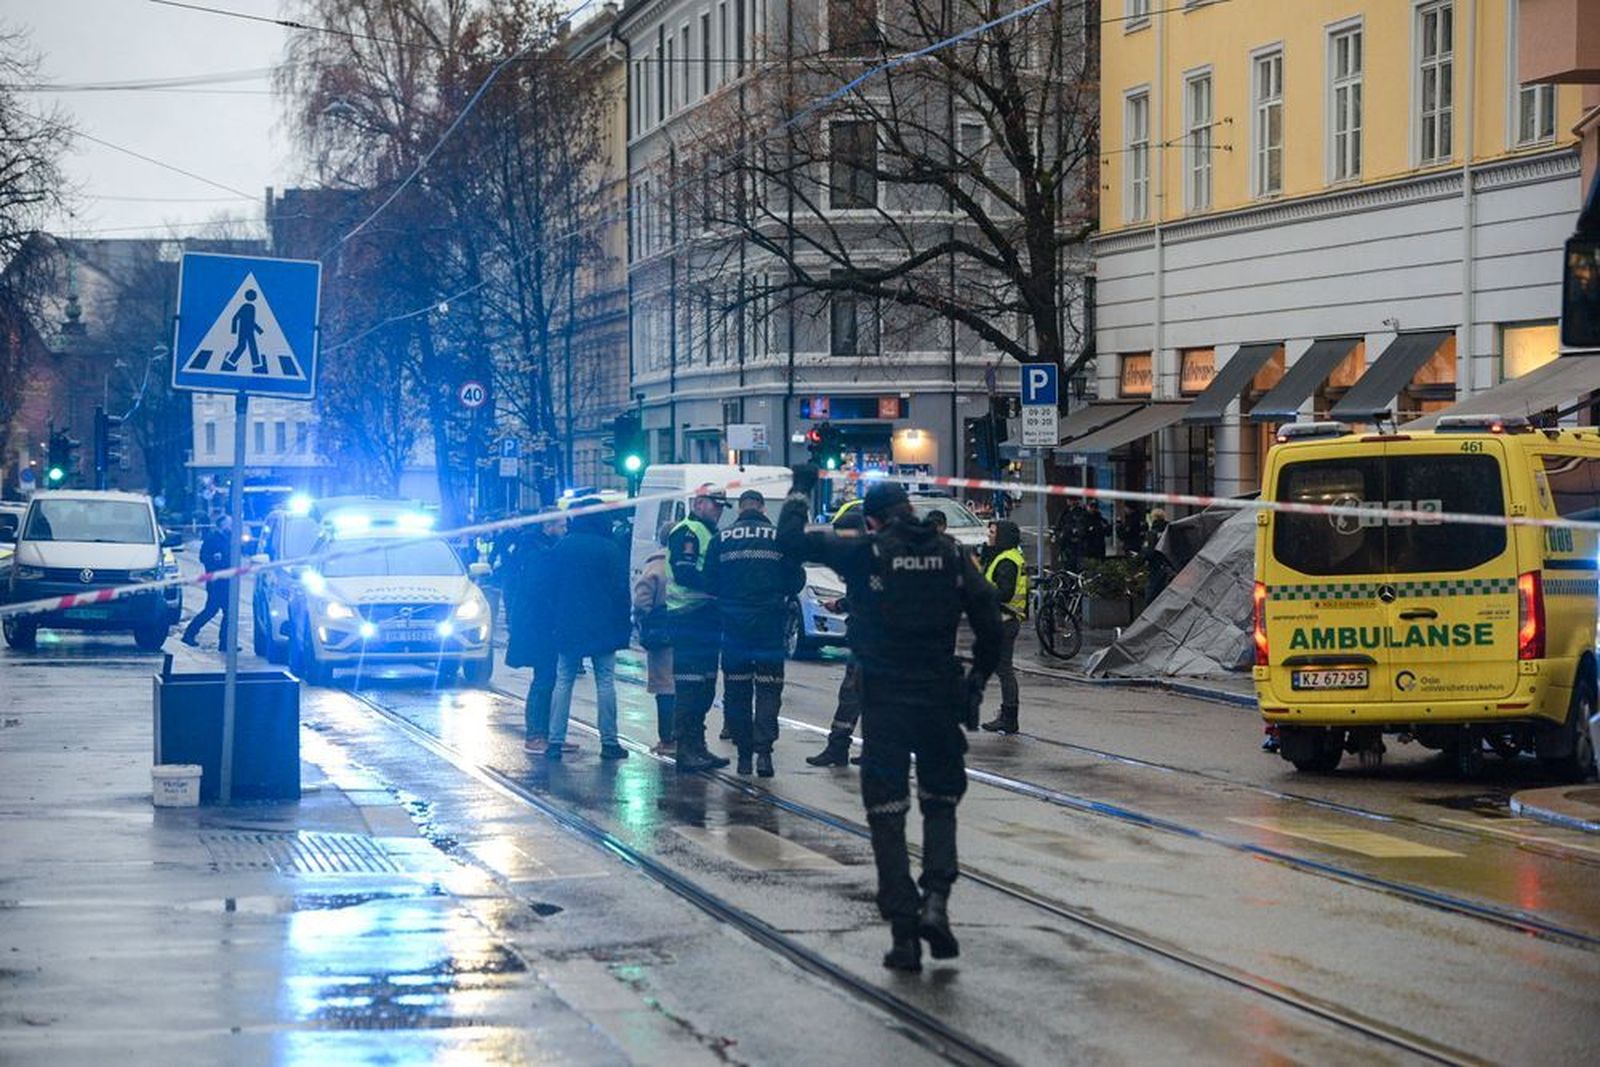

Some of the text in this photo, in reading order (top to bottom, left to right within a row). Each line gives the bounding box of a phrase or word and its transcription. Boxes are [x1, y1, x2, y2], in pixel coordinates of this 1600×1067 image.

[1029, 369, 1049, 400] P
[463, 388, 482, 402] 40
[503, 440, 515, 456] P
[1460, 441, 1484, 452] 461
[892, 556, 944, 570] POLITI
[1289, 623, 1494, 650] AMBULANSE
[1302, 671, 1364, 685] KZ 67295
